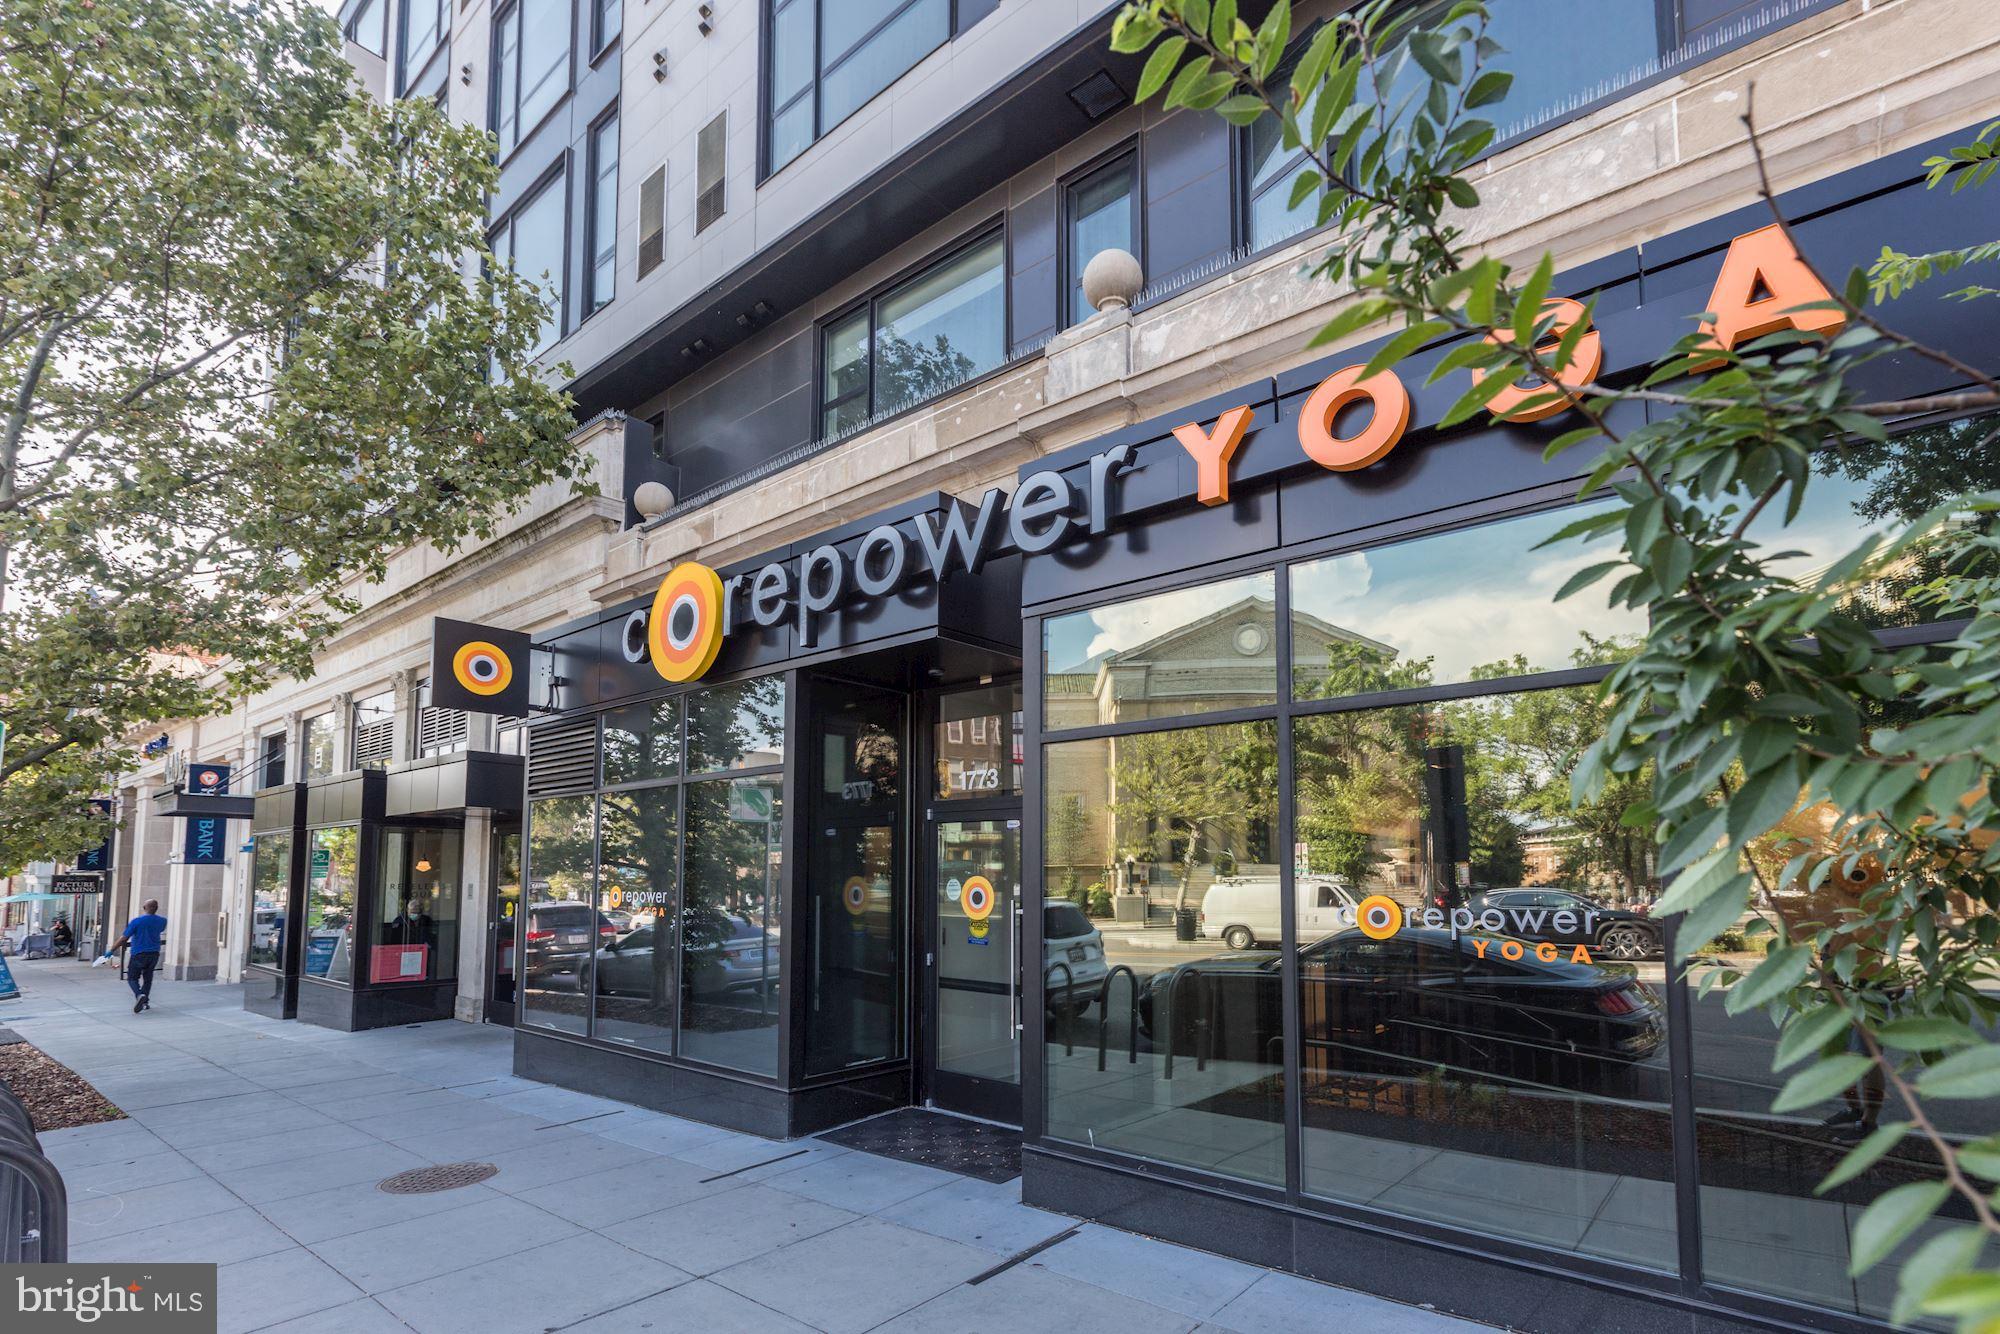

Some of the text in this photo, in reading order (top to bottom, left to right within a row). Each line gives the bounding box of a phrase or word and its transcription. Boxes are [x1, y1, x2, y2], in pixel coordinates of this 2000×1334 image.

[622, 223, 1847, 682] corepower YOGA
[958, 768, 999, 791] 1773
[197, 818, 215, 859] BANK
[605, 885, 669, 910] orepower
[1336, 895, 1601, 941] corepower
[1472, 940, 1594, 965] YOGA
